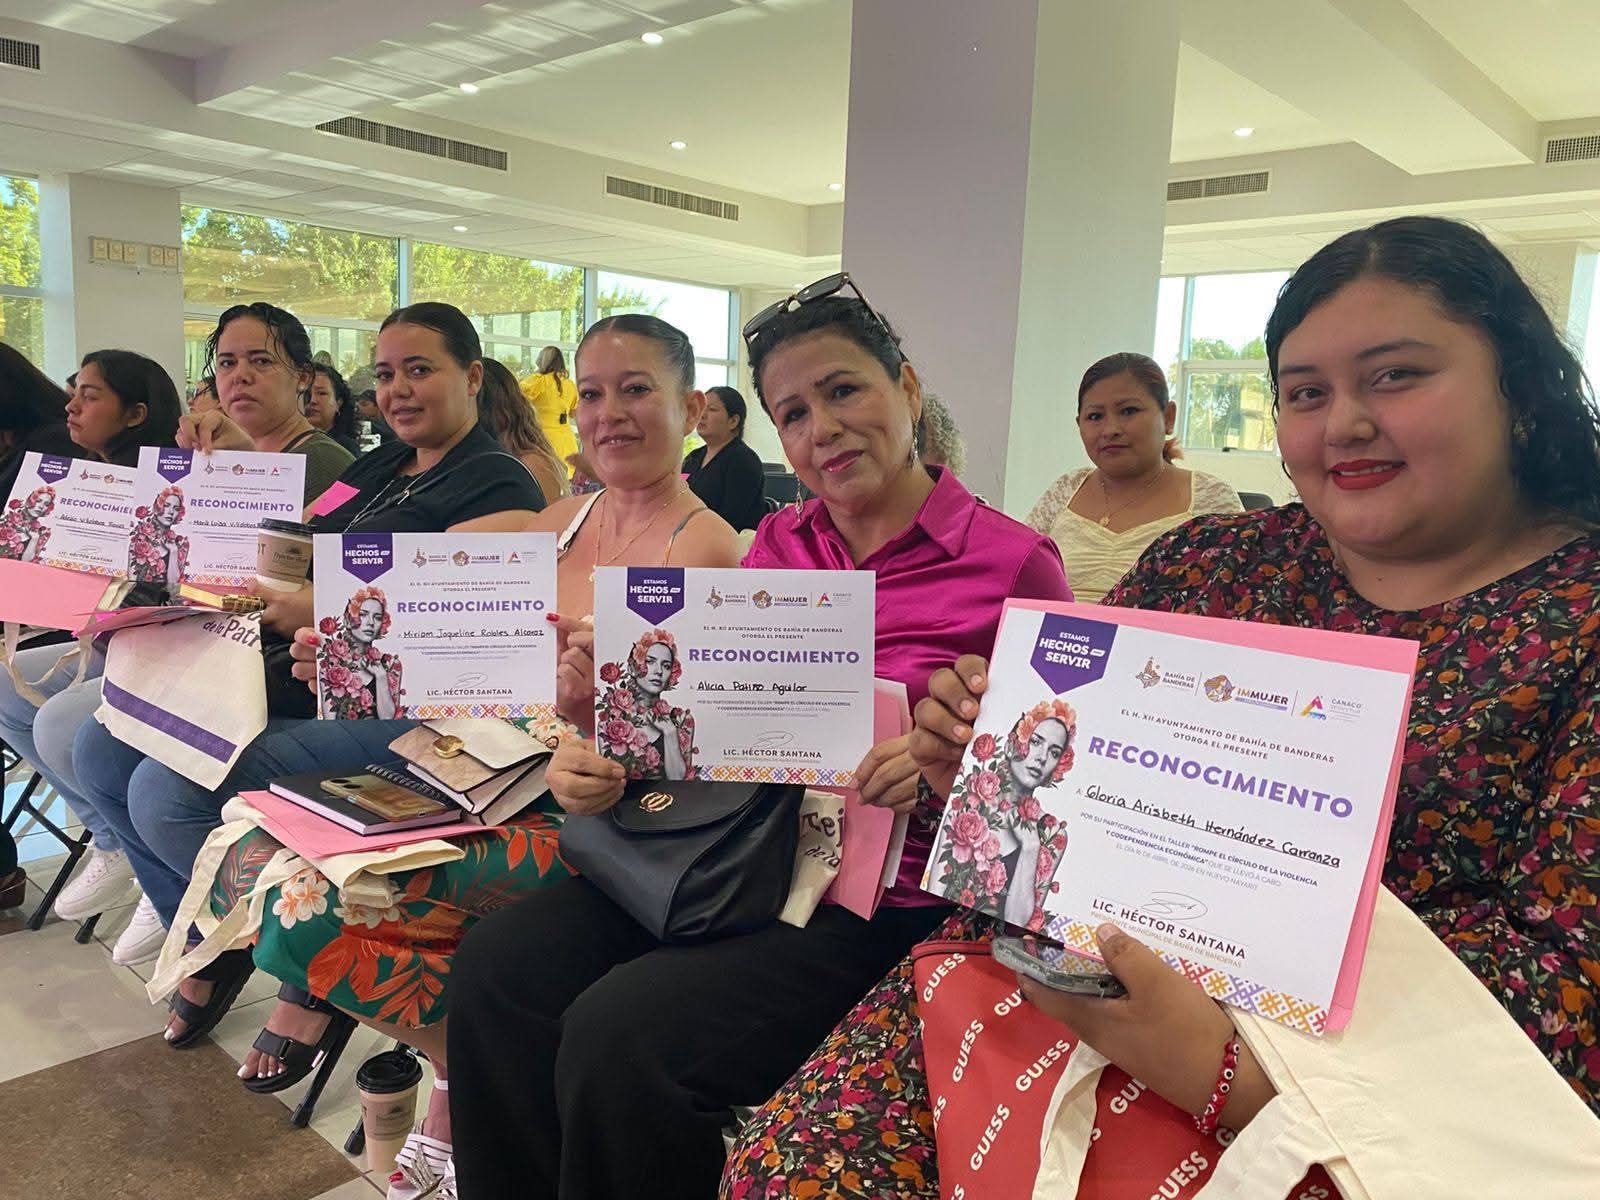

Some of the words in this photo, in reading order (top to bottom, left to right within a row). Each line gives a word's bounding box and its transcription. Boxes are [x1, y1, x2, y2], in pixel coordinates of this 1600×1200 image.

[60, 497, 133, 514] RECONOCIMIE
[190, 499, 294, 512] RECONOCIMIENTO
[630, 586, 669, 594] HECHOS
[398, 600, 544, 612] RECONOCIMIENTO
[222, 619, 260, 647] Patr
[1060, 632, 1090, 642] ESTAMOS
[689, 649, 860, 663] RECONOCIMIENTO
[1039, 638, 1090, 655] HECHOS
[1045, 652, 1091, 669] SERVIR
[698, 681, 724, 691] Alicia
[772, 682, 807, 695] Aguilar
[1162, 678, 1194, 689] BANDERAS
[1238, 688, 1288, 705] IMMUJER
[1121, 708, 1130, 716] EL
[1142, 714, 1154, 722] XII
[1156, 716, 1223, 737] AYUNTAMIENTO
[1225, 732, 1237, 741] DE
[1239, 734, 1266, 748] BAHÍA
[1269, 742, 1281, 751] DE
[1284, 746, 1335, 763] BANDERAS
[742, 748, 777, 756] HÉCTOR
[780, 750, 822, 758] SANTANA
[1173, 732, 1208, 746] OTORGA
[1211, 740, 1221, 748] EL
[1223, 743, 1269, 760] PRESENTE
[1088, 736, 1353, 818] RECONOCIMIENTO
[1086, 784, 1126, 808] Gloria
[1132, 798, 1196, 828] Arisbeth
[1205, 820, 1276, 850] Hernández
[1282, 840, 1341, 868] Carranza
[1080, 812, 1093, 820] POR
[1094, 815, 1102, 823] SU
[1102, 817, 1149, 837] PARTICIPACIÓN
[1149, 831, 1159, 840] EN
[1159, 834, 1167, 842] EL
[1168, 836, 1190, 849] TALLER
[1228, 853, 1257, 869] CÍRCULO
[1259, 862, 1268, 872] DE
[1269, 866, 1278, 875] LA
[1280, 869, 1318, 887] VIOLENCIA
[1111, 831, 1164, 852] CODEPENDENCIA
[1092, 899, 1116, 916] LIC.
[1120, 908, 1175, 935] HÉCTOR
[1178, 928, 1246, 959] SANTANA
[923, 953, 966, 1002] GUESS
[952, 1019, 984, 1082] GUESS
[1015, 1039, 1070, 1092] GUESS
[970, 1103, 1010, 1171] GUESS
